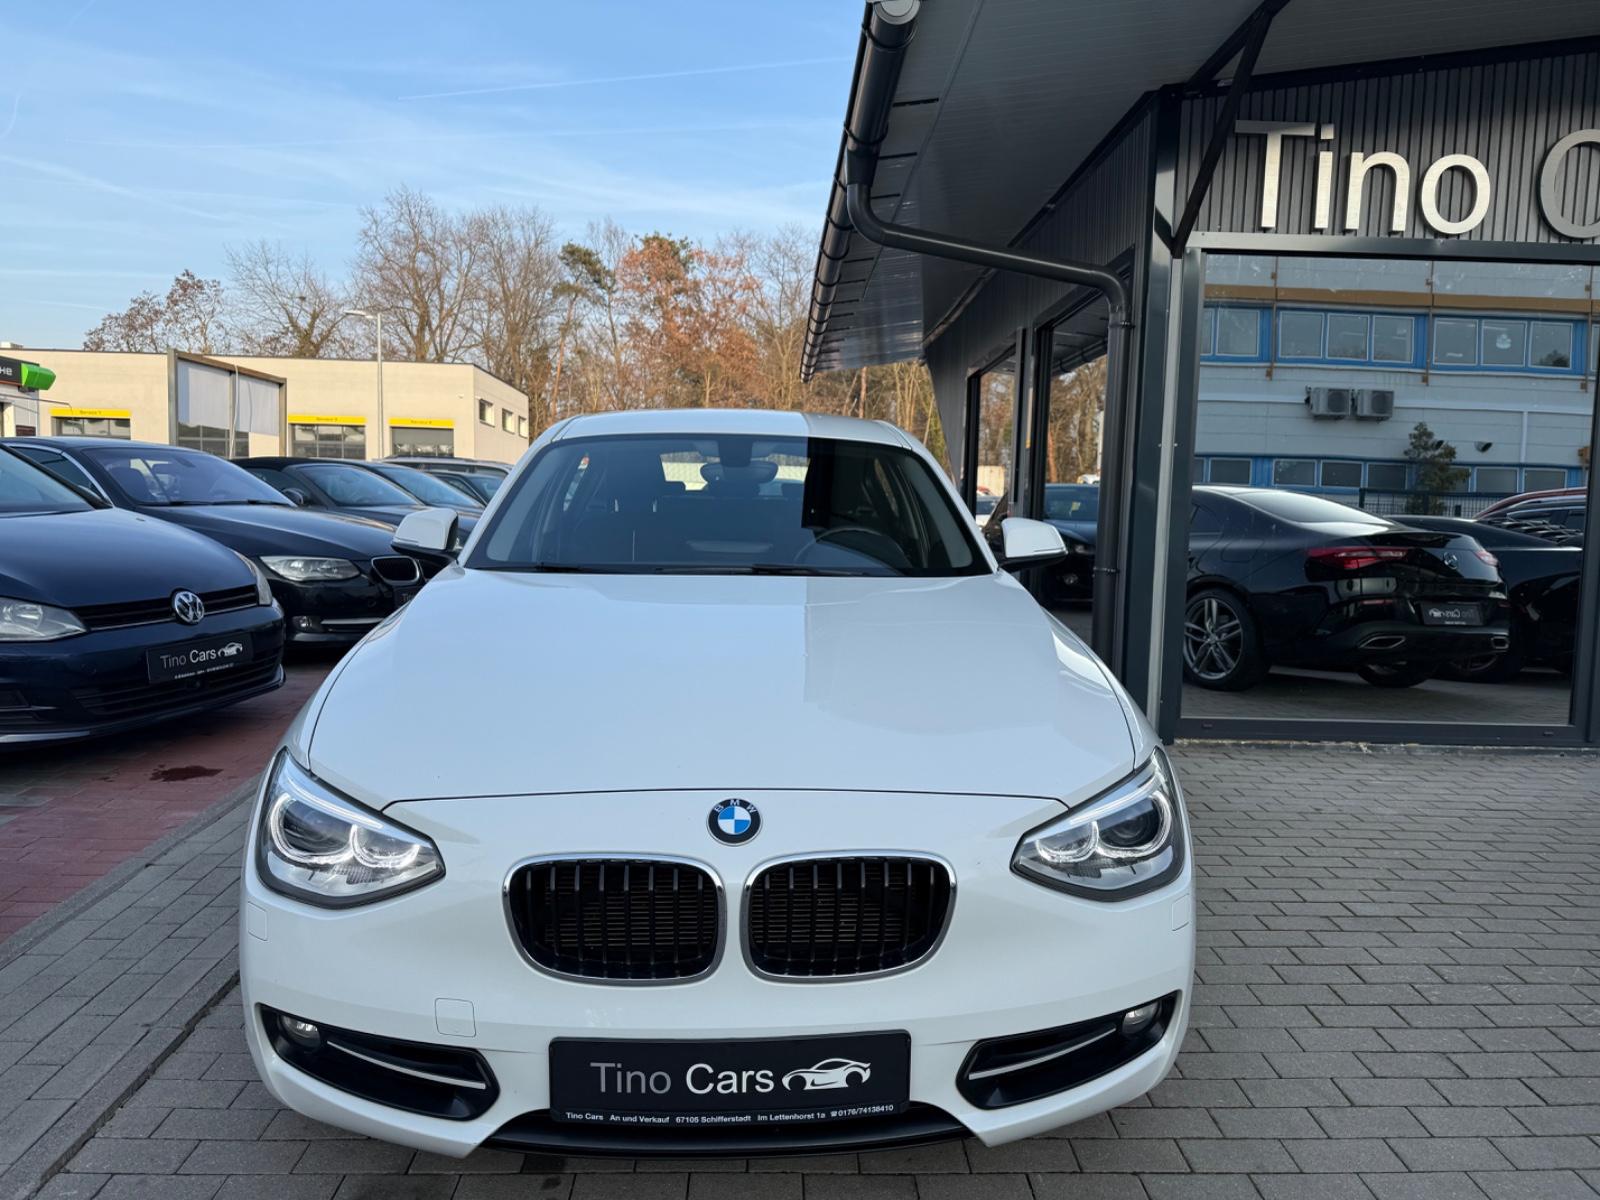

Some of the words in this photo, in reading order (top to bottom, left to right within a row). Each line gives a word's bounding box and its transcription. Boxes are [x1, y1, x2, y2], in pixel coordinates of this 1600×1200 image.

[1234, 119, 1490, 235] Tino
[160, 654, 187, 669] Tino
[189, 649, 217, 663] Cars
[713, 798, 758, 813] BMW
[590, 1062, 672, 1094] Tino
[685, 1063, 774, 1094] Cars
[566, 1112, 583, 1120] Tino
[585, 1113, 603, 1121] Cars
[609, 1114, 620, 1122] An
[622, 1115, 637, 1123] und
[639, 1116, 670, 1124] Verkauf
[675, 1116, 699, 1124] 67105
[701, 1115, 751, 1124] Schifferstadt
[769, 1113, 815, 1121] Lettenhorst
